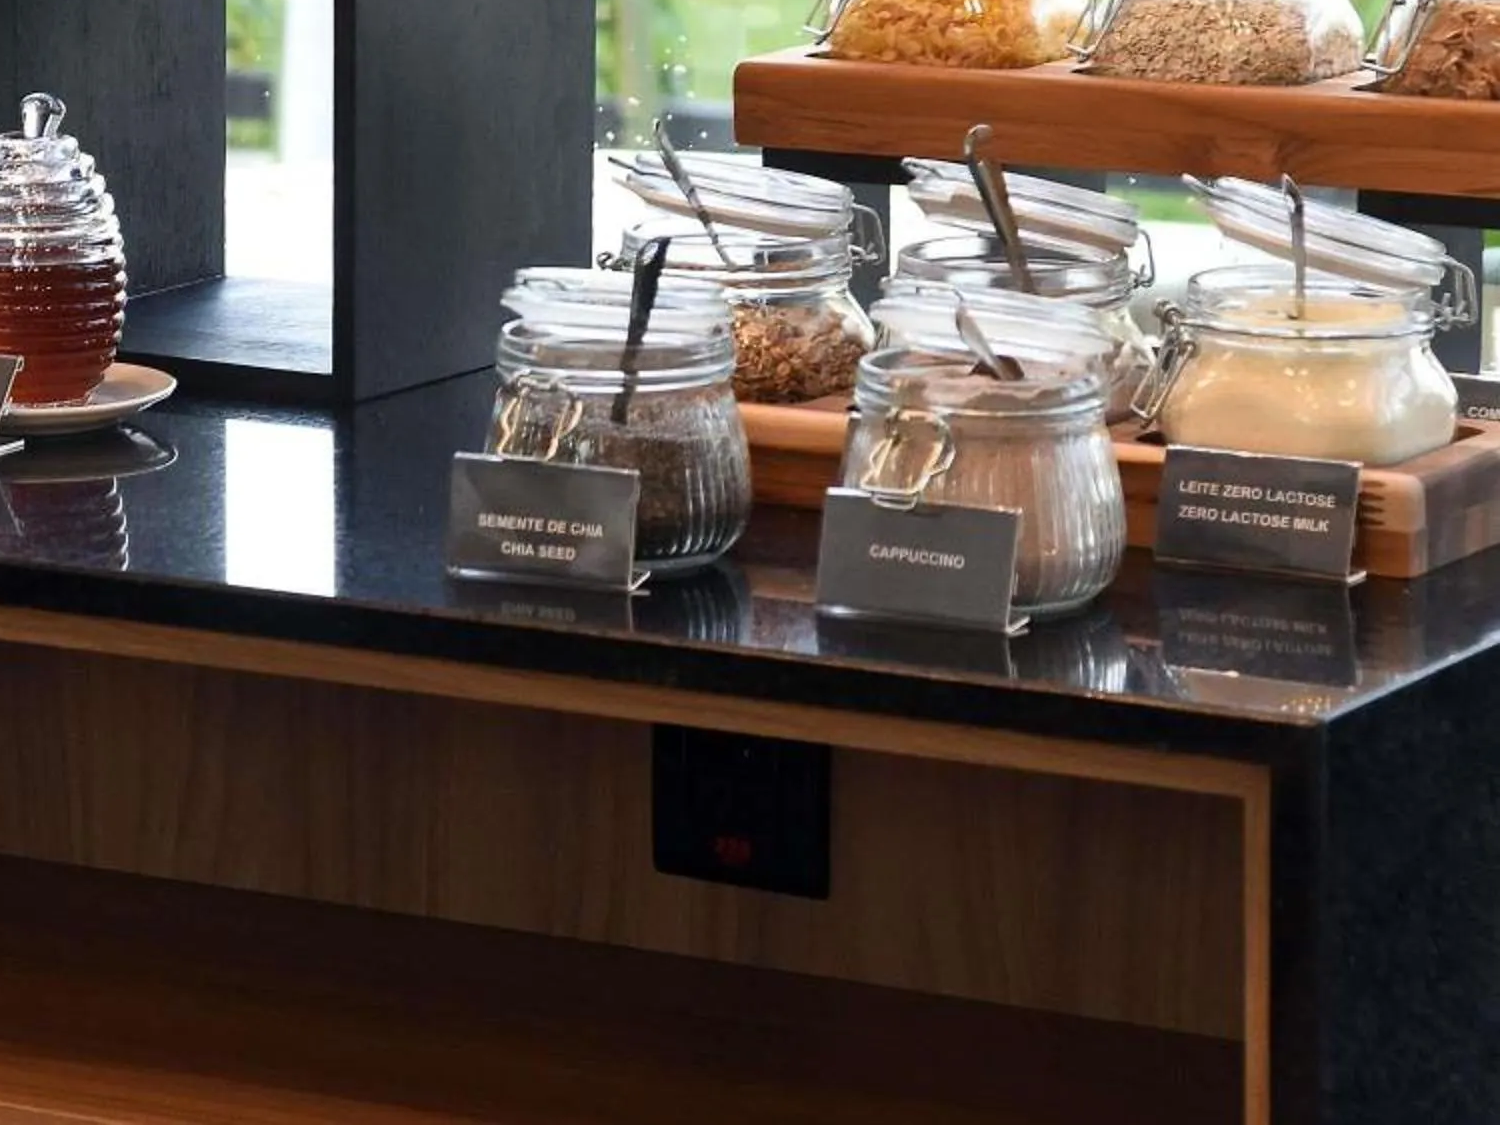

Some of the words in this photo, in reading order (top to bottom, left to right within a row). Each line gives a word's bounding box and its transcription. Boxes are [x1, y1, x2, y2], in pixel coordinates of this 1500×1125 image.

[1179, 479, 1221, 497] LEITE
[1222, 484, 1263, 501] ZERO
[1266, 488, 1336, 509] LACTOSE
[478, 513, 545, 532] SEMENTE
[547, 520, 567, 535] DE
[570, 522, 604, 538] CHIA
[1178, 505, 1219, 521] ZERO
[1221, 509, 1290, 529] LACTOSE
[1293, 518, 1330, 533] MILK
[501, 541, 535, 557] CHIA
[538, 545, 577, 562] SEED
[869, 544, 966, 569] CAPPUCCINO
